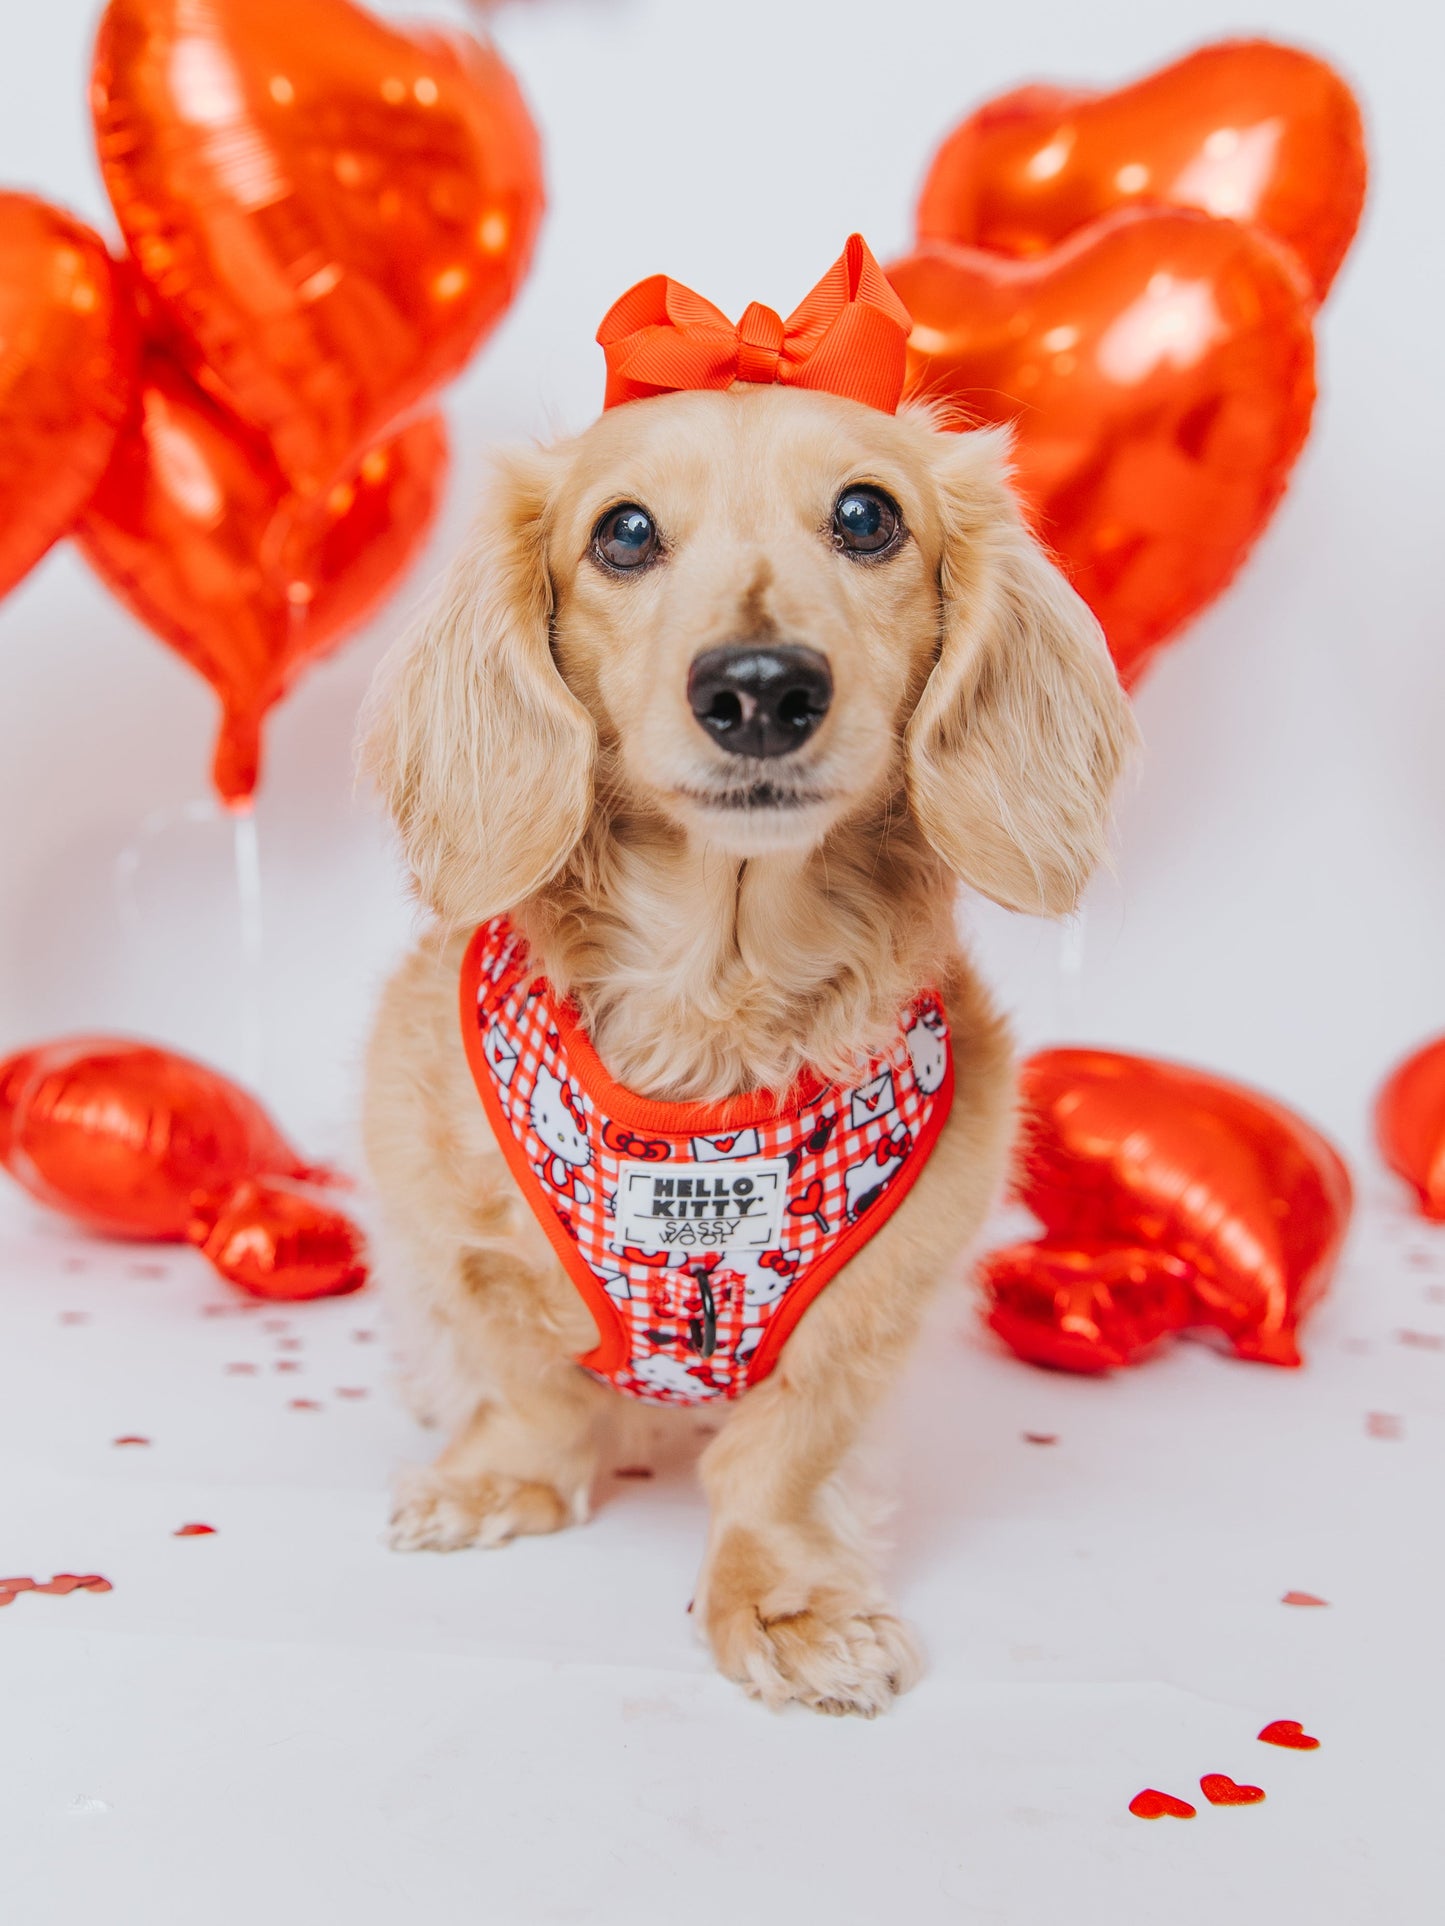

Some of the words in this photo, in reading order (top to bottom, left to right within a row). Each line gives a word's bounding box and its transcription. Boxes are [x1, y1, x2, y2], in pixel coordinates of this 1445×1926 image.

[653, 1177, 754, 1197] HELLO
[652, 1197, 757, 1217] KITTY
[665, 1220, 741, 1235] SASSY
